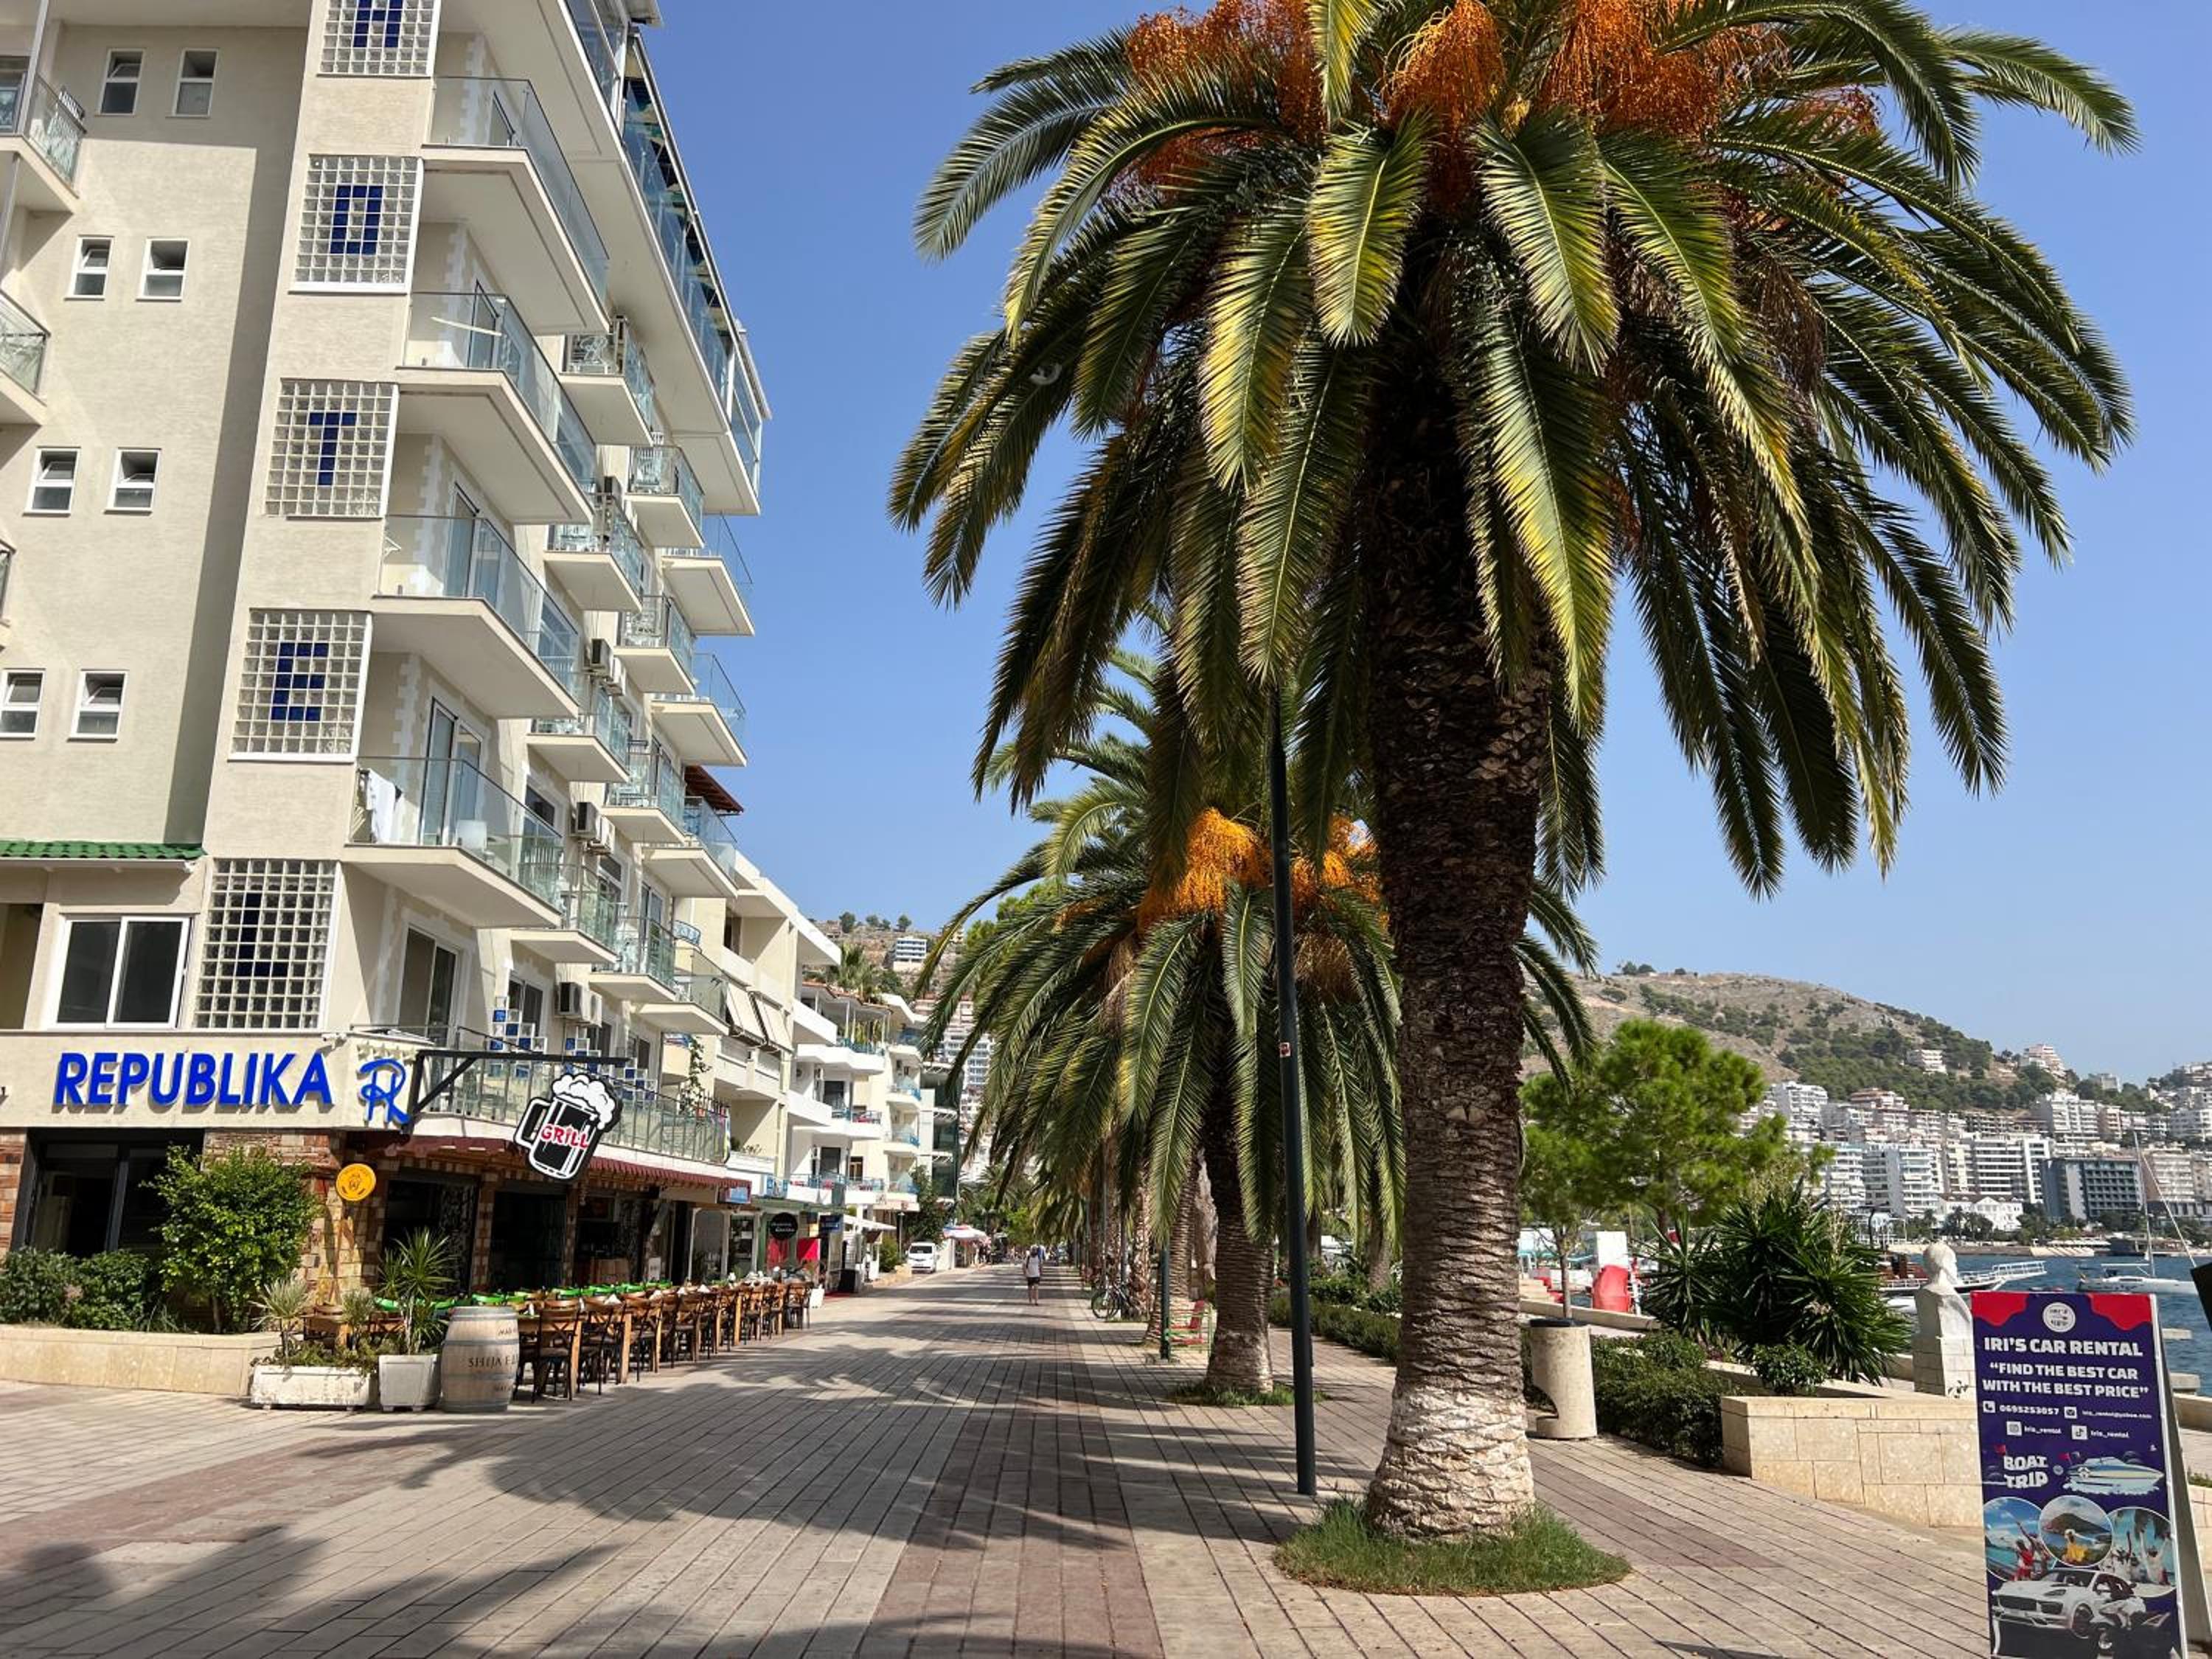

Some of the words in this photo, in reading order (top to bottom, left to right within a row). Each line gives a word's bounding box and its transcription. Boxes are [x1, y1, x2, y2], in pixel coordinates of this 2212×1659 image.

[54, 1052, 335, 1105] REPUBLIKA
[540, 1124, 589, 1150] GRILL
[1983, 1337, 2027, 1352] IRI'S
[2030, 1338, 2067, 1354] CAR
[2070, 1341, 2143, 1357] RENTAL
[2037, 1365, 2065, 1377] THE
[2067, 1366, 2105, 1378] BEST
[2107, 1368, 2138, 1380] CAR
[1982, 1380, 2021, 1392] WITH
[2023, 1381, 2052, 1394] THE
[2054, 1383, 2092, 1396] BEST
[2003, 1455, 2048, 1471] BOAT
[2003, 1471, 2049, 1489] TRIP
